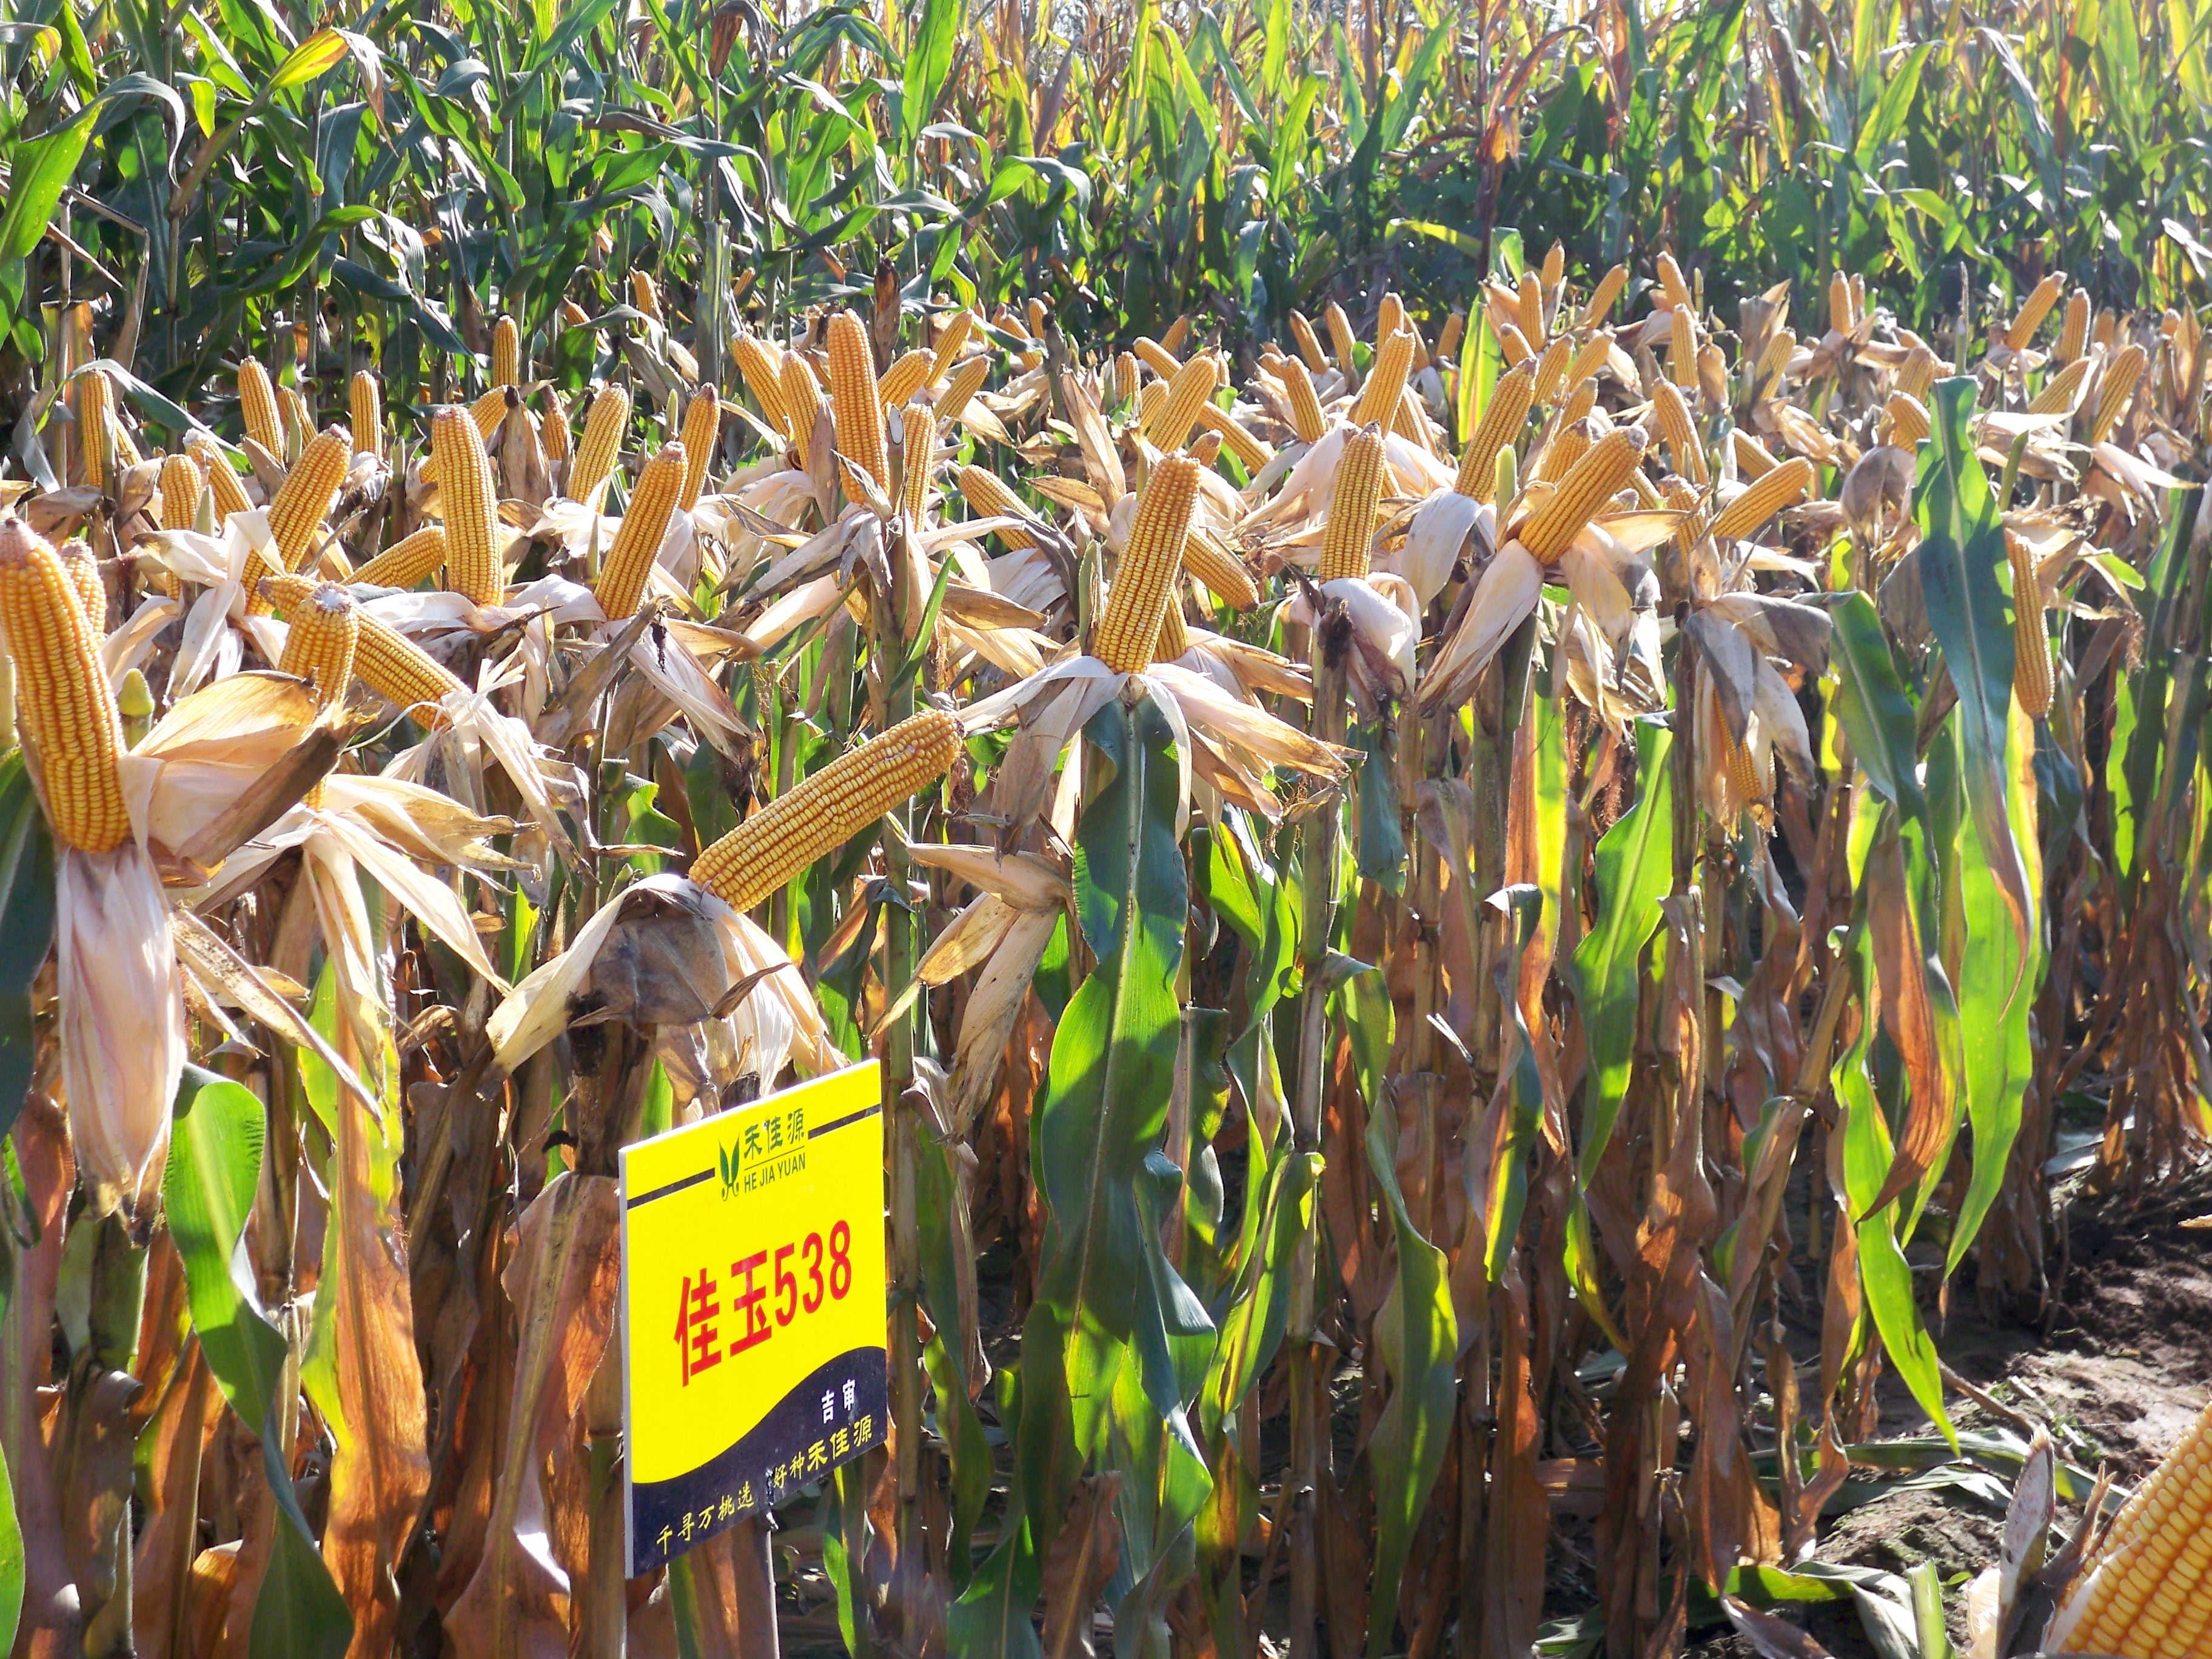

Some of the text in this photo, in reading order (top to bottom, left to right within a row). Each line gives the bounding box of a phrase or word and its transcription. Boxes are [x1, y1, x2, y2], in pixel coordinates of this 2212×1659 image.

[744, 1108, 805, 1161] 禾佳源
[745, 1153, 806, 1193] HE JIA YUAN
[674, 1219, 852, 1387] 佳玉538
[821, 1378, 856, 1424] 吉审
[656, 1414, 873, 1555] 千寻万挑选 好种禾佳源
